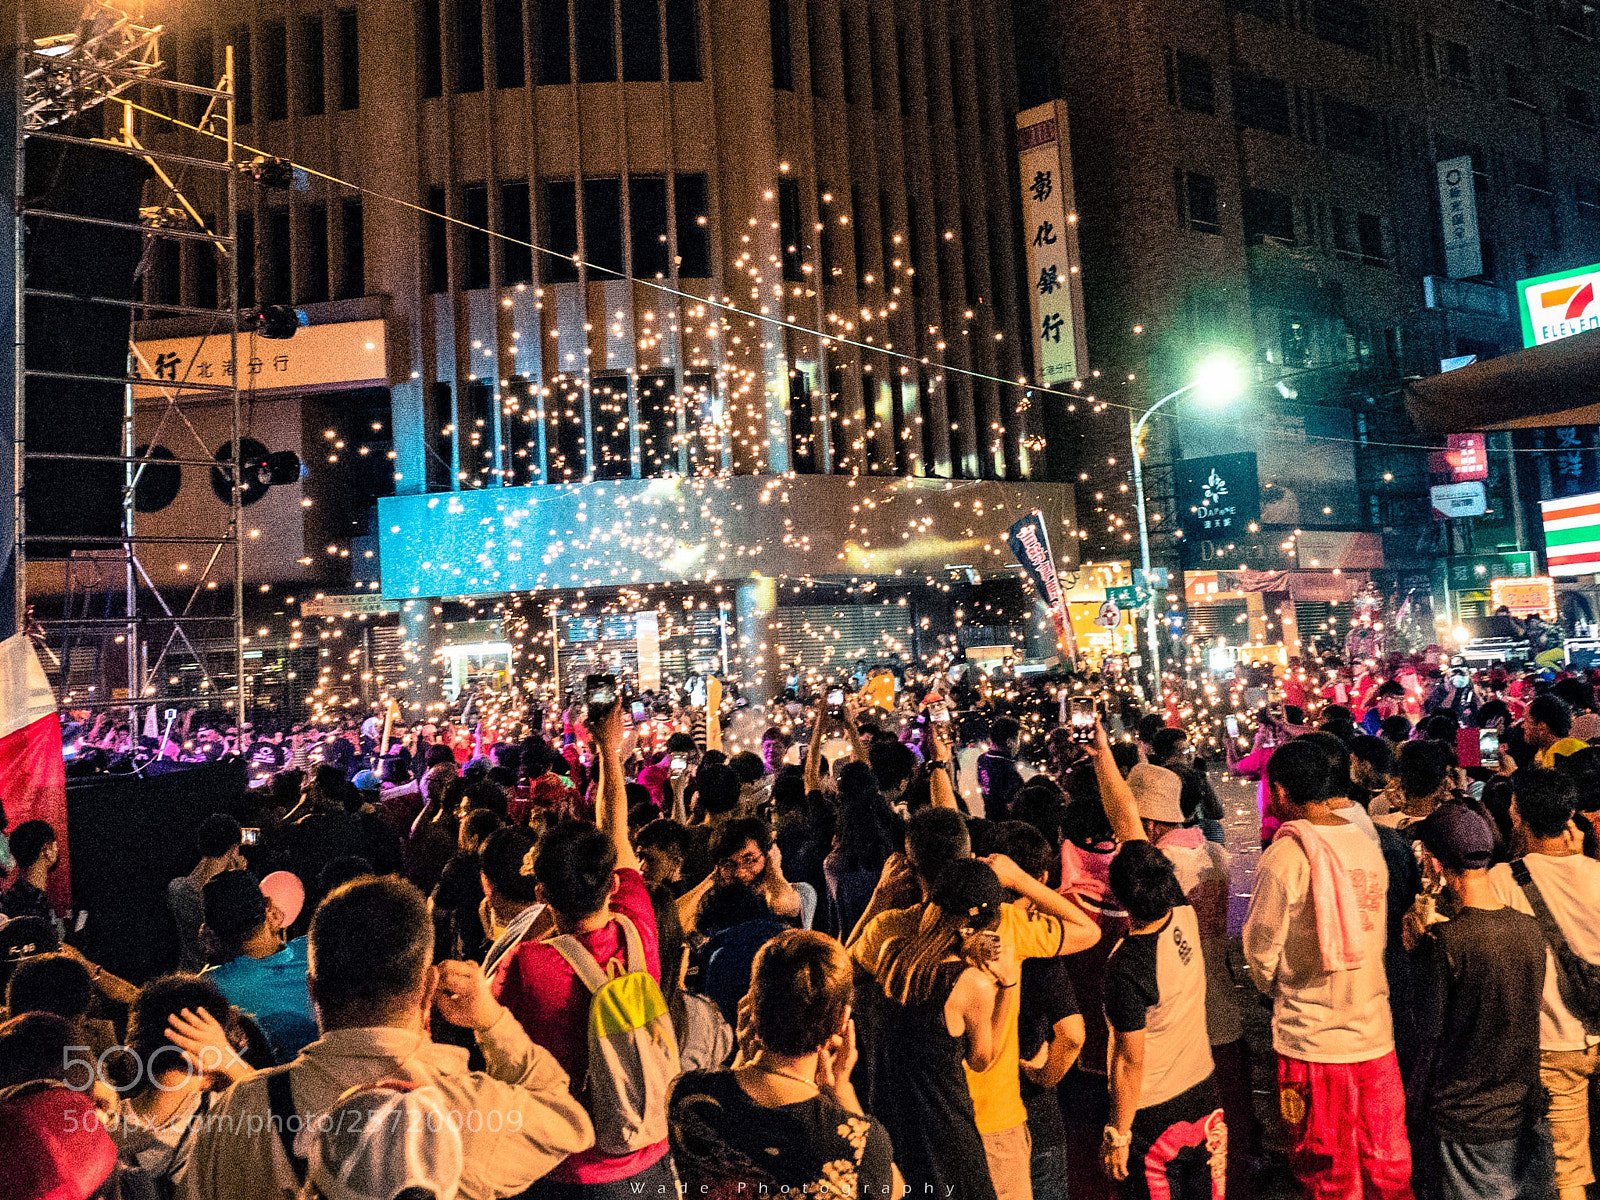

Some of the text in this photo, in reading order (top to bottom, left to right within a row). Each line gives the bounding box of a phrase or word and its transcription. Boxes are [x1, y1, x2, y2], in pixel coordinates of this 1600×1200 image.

[1030, 171, 1064, 343] 彰化銀行
[1541, 282, 1594, 320] 7
